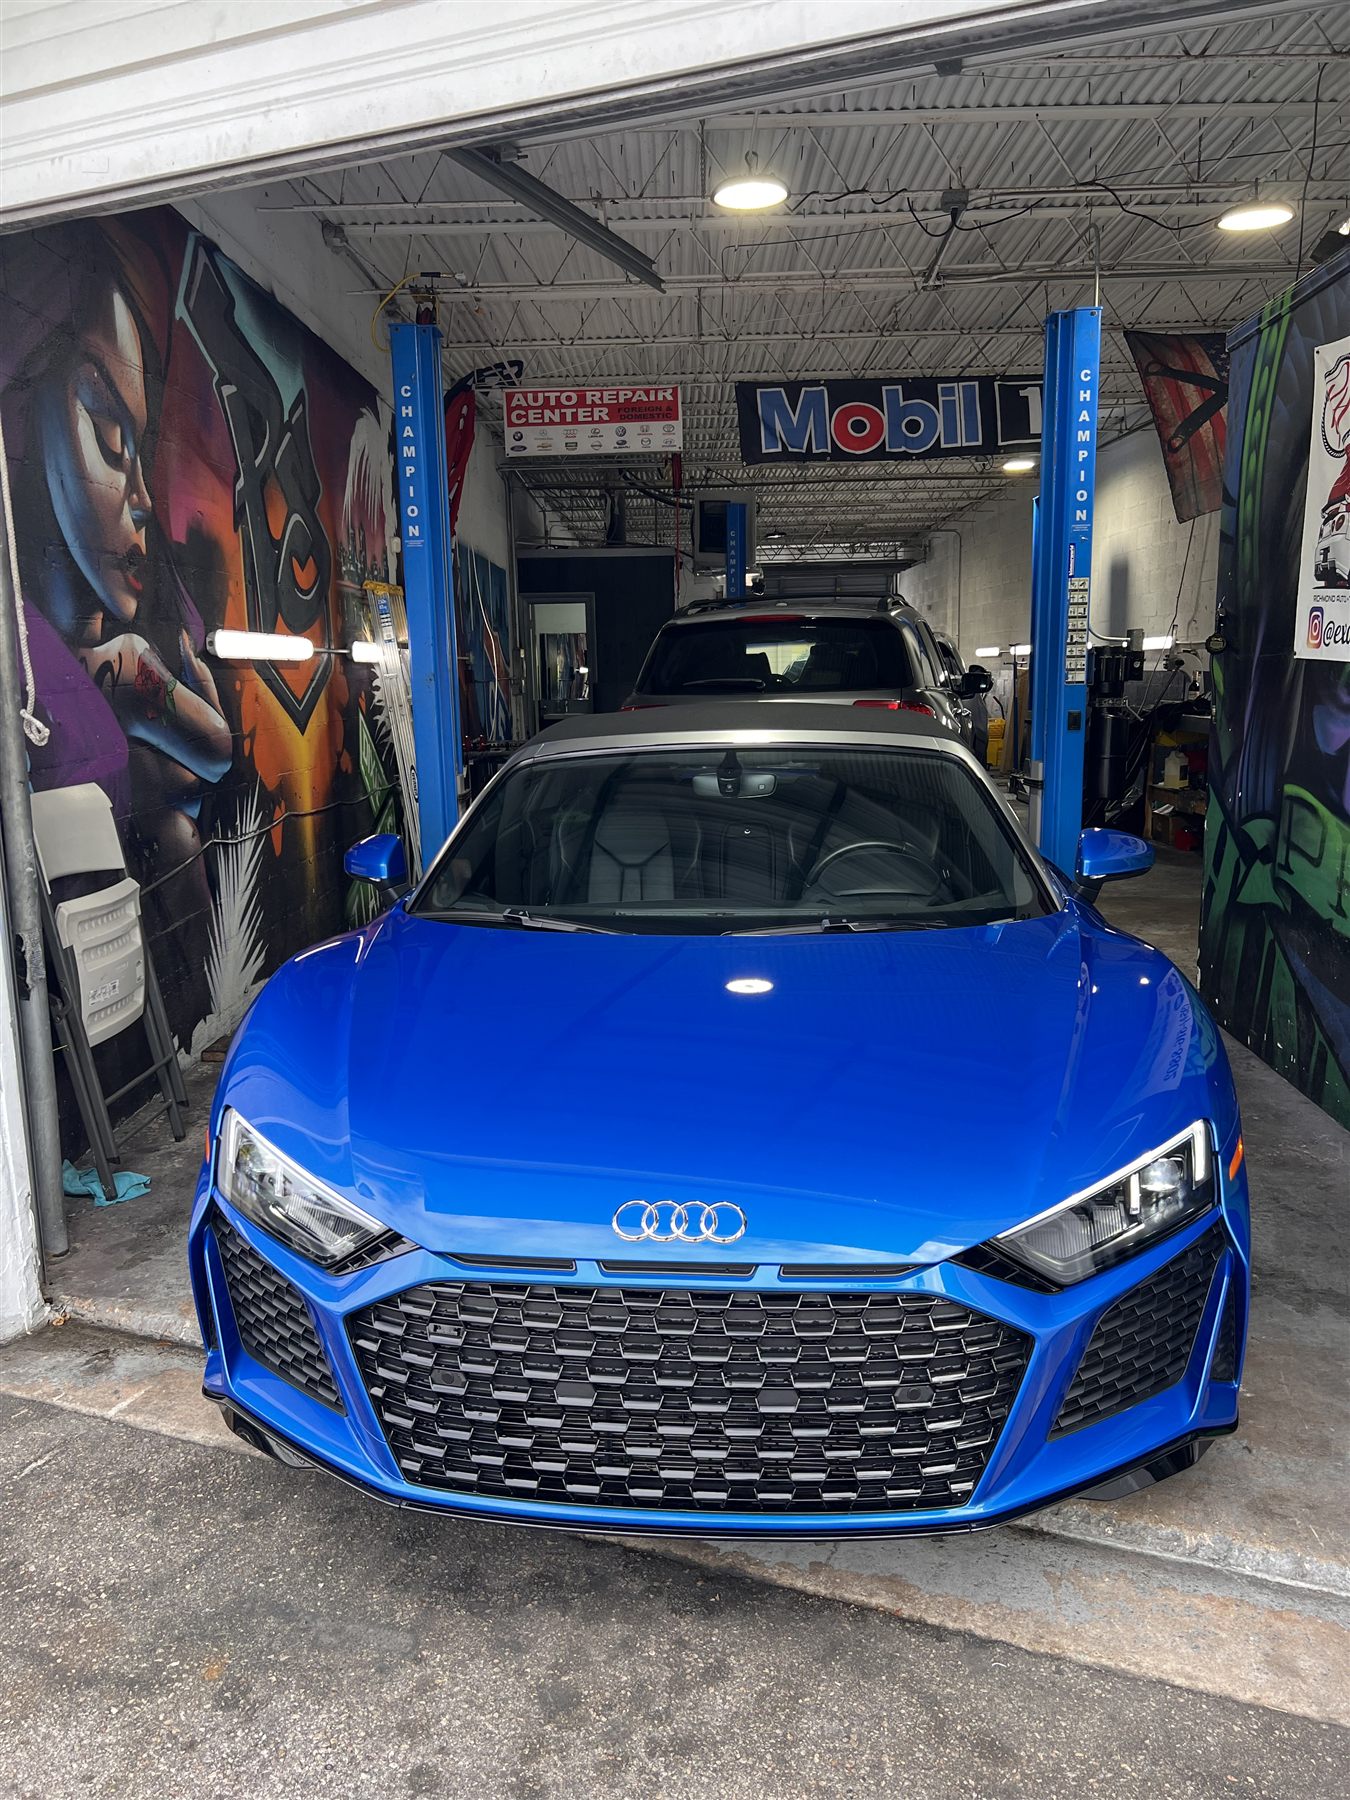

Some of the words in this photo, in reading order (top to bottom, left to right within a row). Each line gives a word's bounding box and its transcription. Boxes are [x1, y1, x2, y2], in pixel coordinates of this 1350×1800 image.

[510, 391, 578, 407] AUTO
[585, 388, 674, 405] REPAIR
[510, 407, 610, 424] CENTER
[617, 406, 662, 414] FOREIGN
[619, 412, 673, 420] DOMESTIC
[757, 381, 983, 454] Mobil
[1019, 386, 1043, 434] 1
[1075, 369, 1092, 521] CHAMPION
[400, 385, 420, 537] CHAMPION
